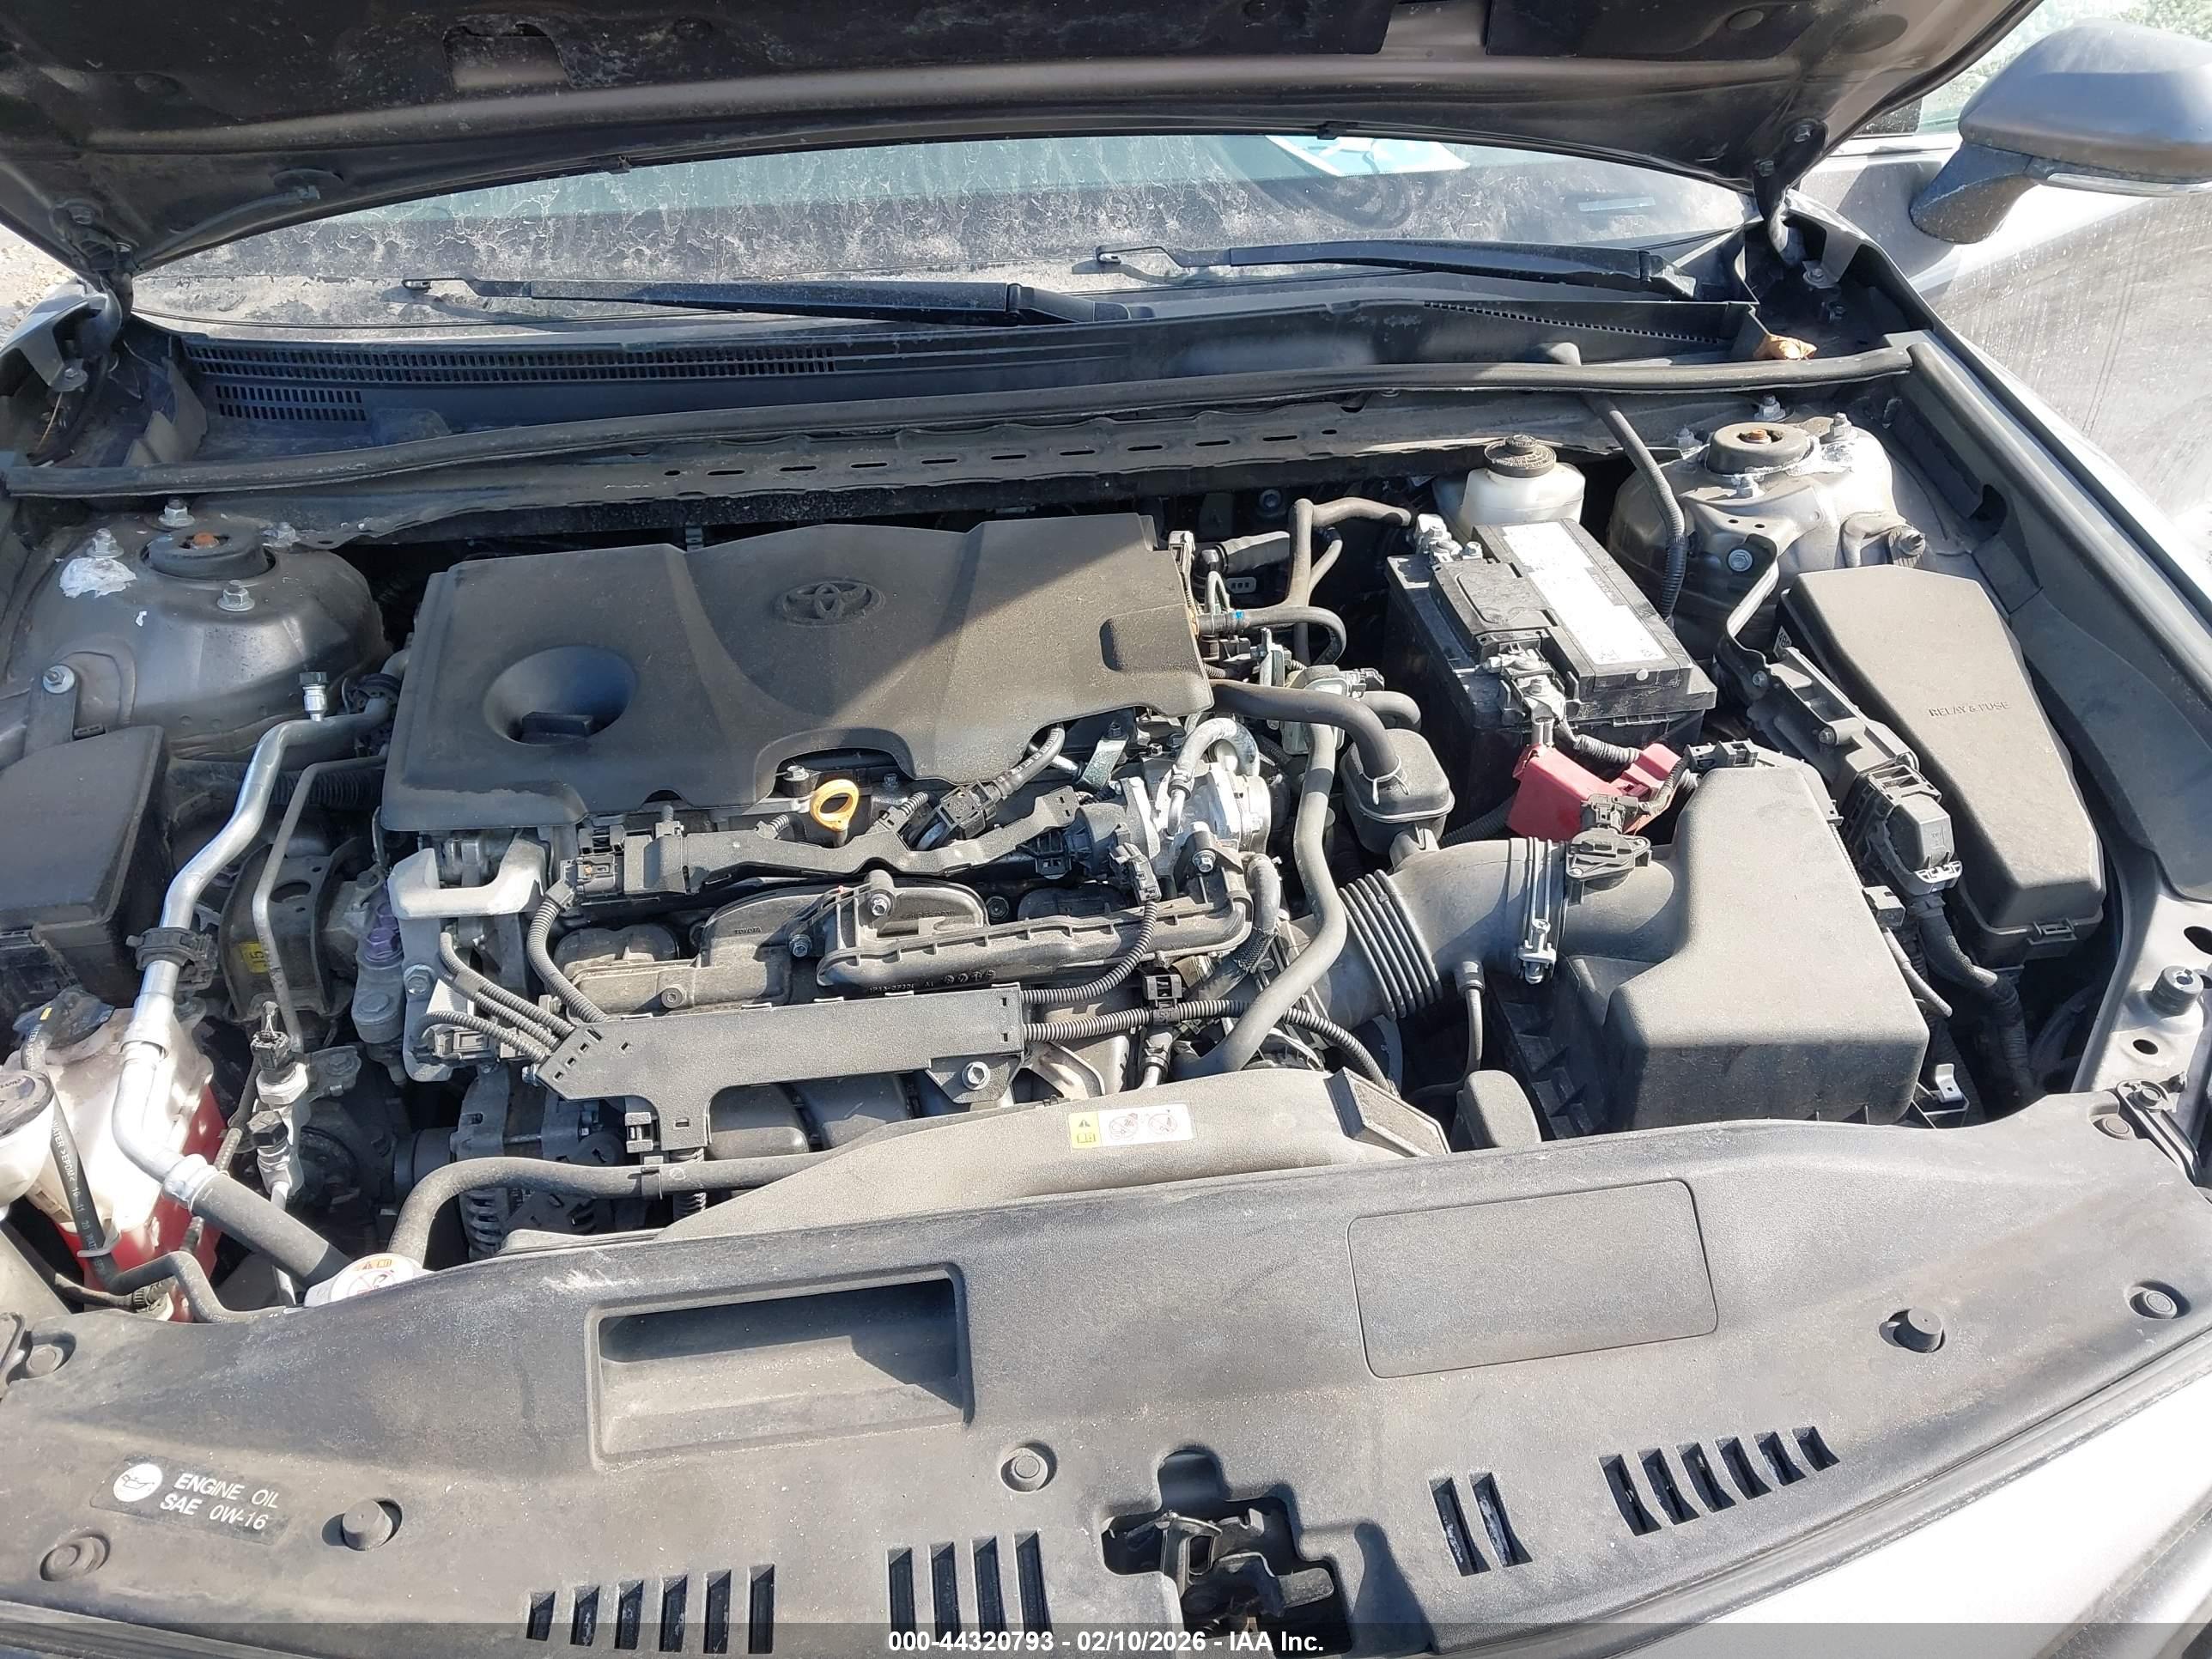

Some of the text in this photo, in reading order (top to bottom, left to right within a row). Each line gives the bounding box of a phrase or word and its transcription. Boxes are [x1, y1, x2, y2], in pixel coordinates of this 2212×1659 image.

[1929, 706, 1966, 717] RELAY
[1978, 702, 2009, 712] FUSE
[52, 1119, 65, 1148] WATER
[173, 1473, 279, 1509] ENGINE OIL
[160, 1493, 269, 1530] SAE 0W-16
